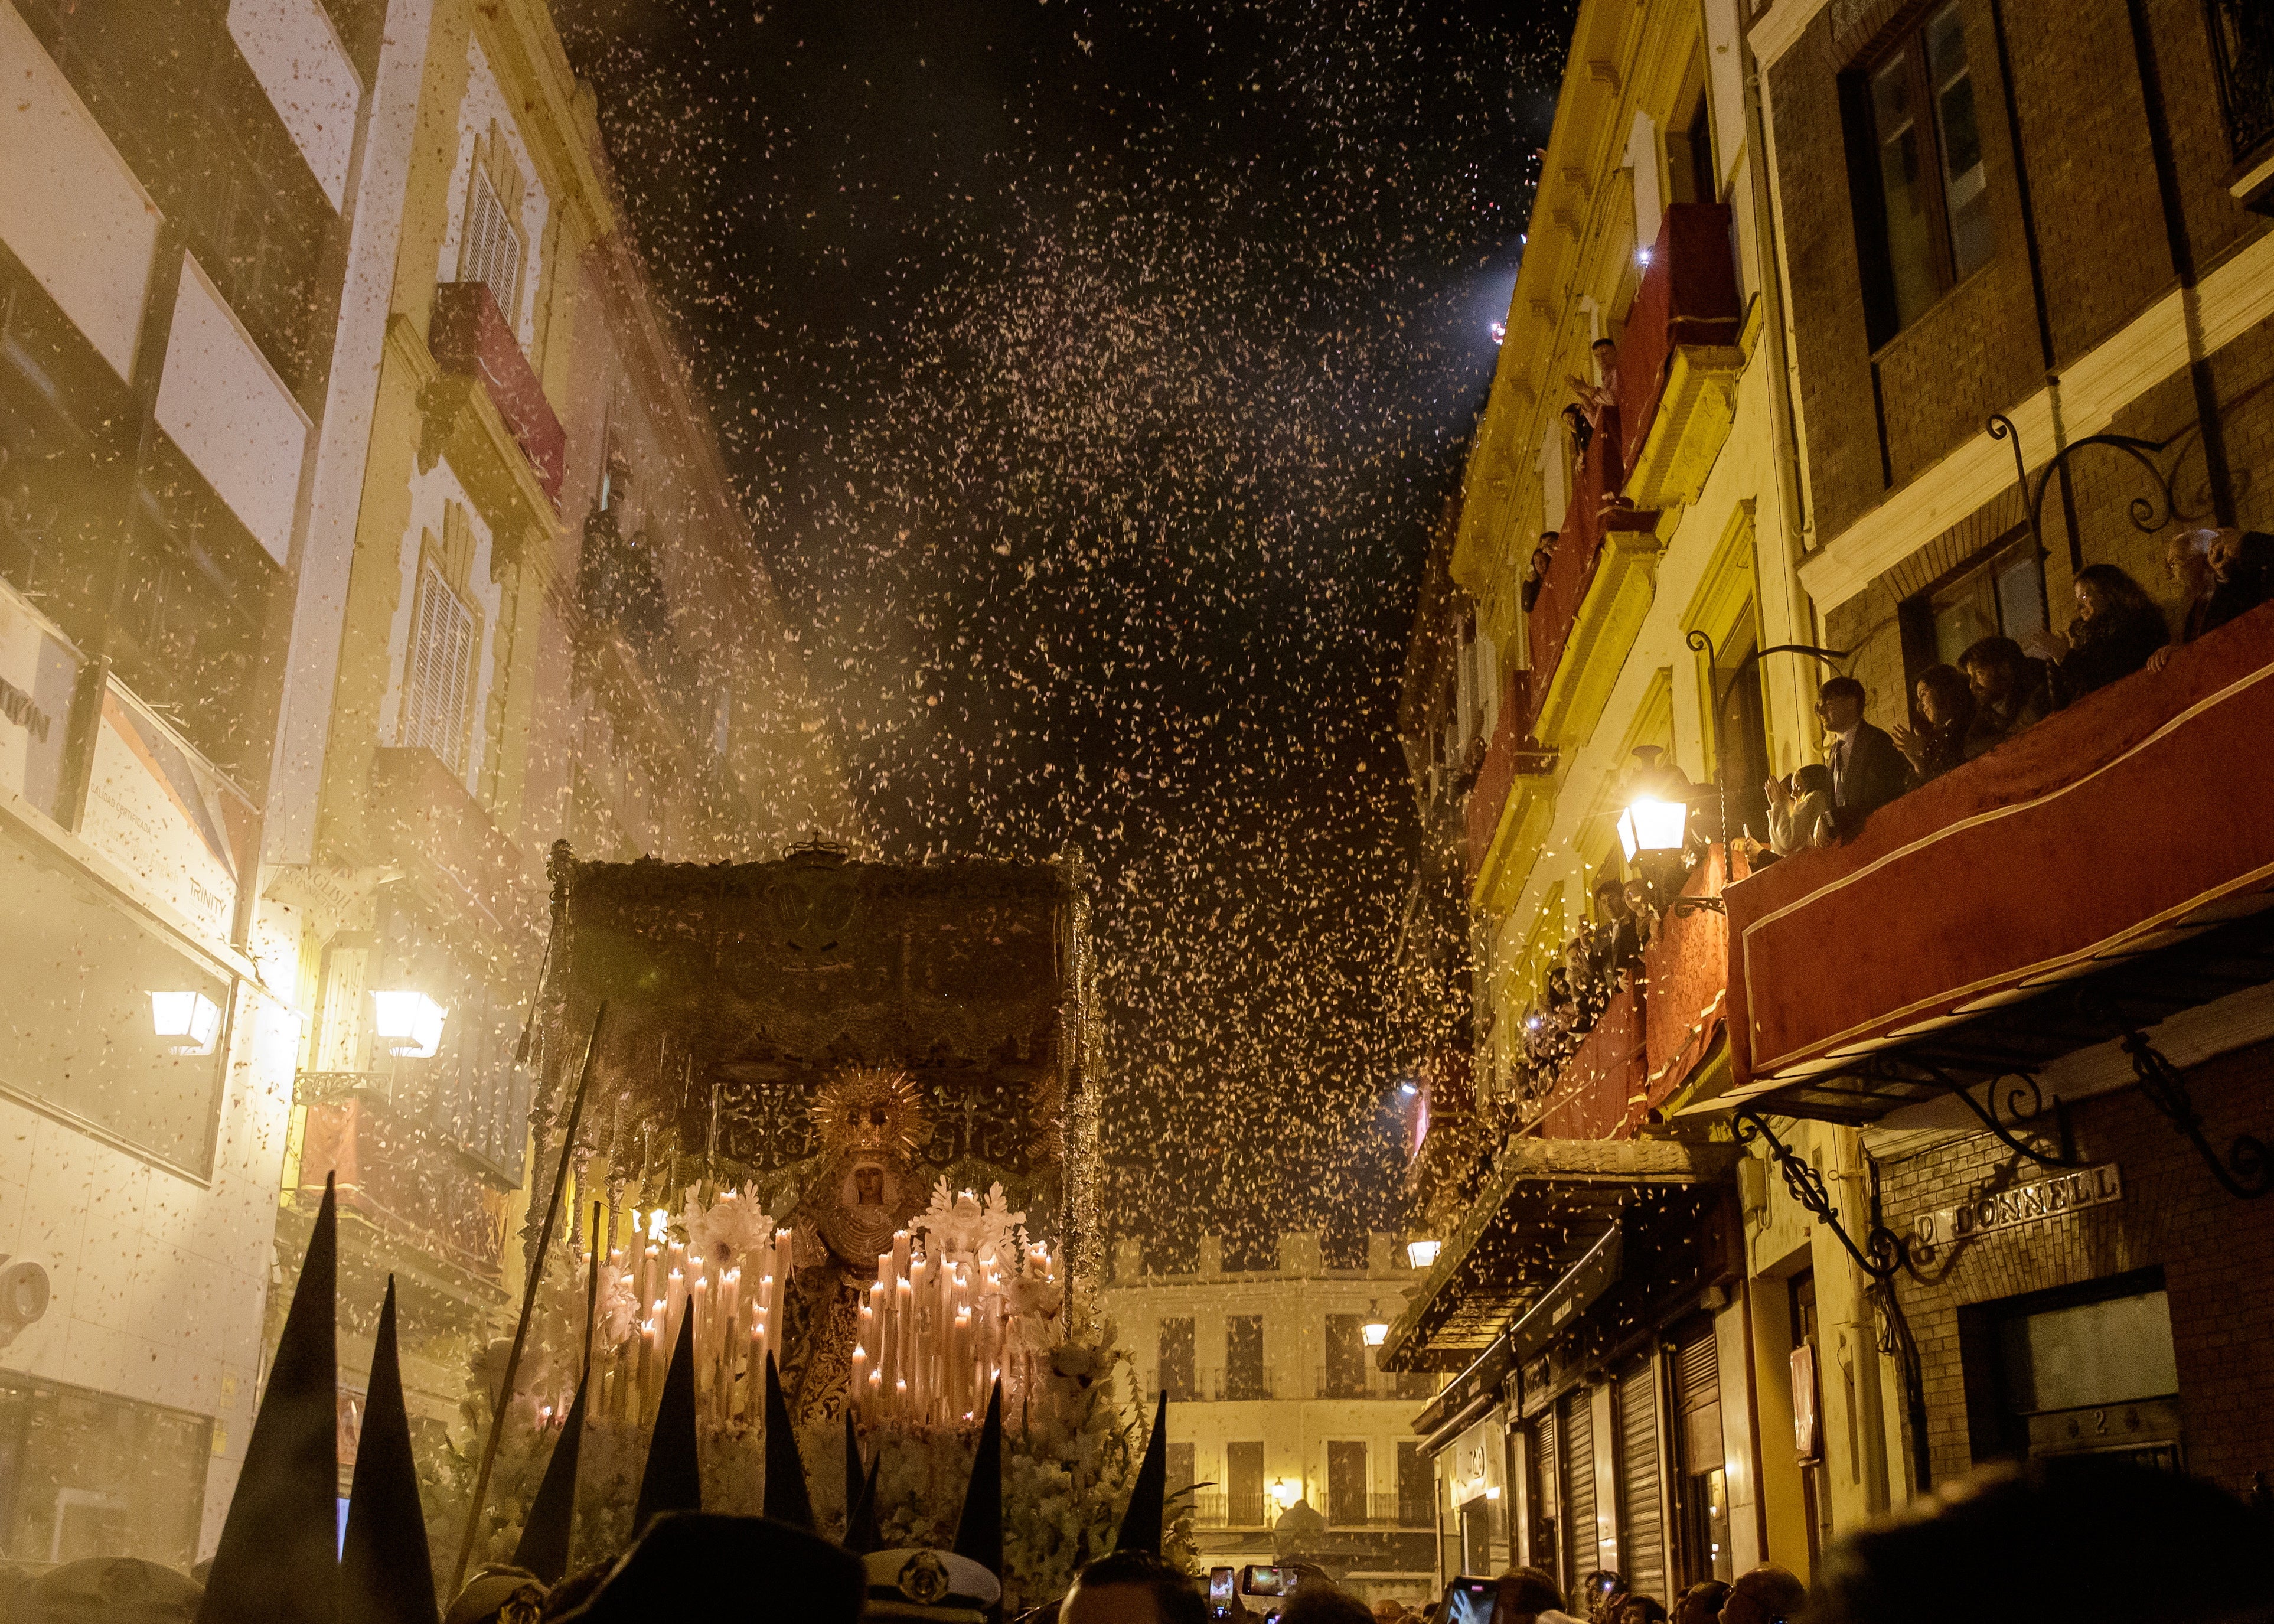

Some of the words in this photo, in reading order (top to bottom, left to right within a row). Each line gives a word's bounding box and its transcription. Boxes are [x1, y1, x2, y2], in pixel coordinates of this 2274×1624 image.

[91, 783, 115, 808] CALIDAD
[116, 802, 151, 834] CERTIFICADA
[103, 817, 149, 863] Camidge
[190, 877, 227, 918] TRINITY
[296, 864, 352, 909] NGLISH
[1919, 1215, 1934, 1242] O
[1956, 1169, 2118, 1234] DONNELL
[2094, 1409, 2105, 1434] 2
